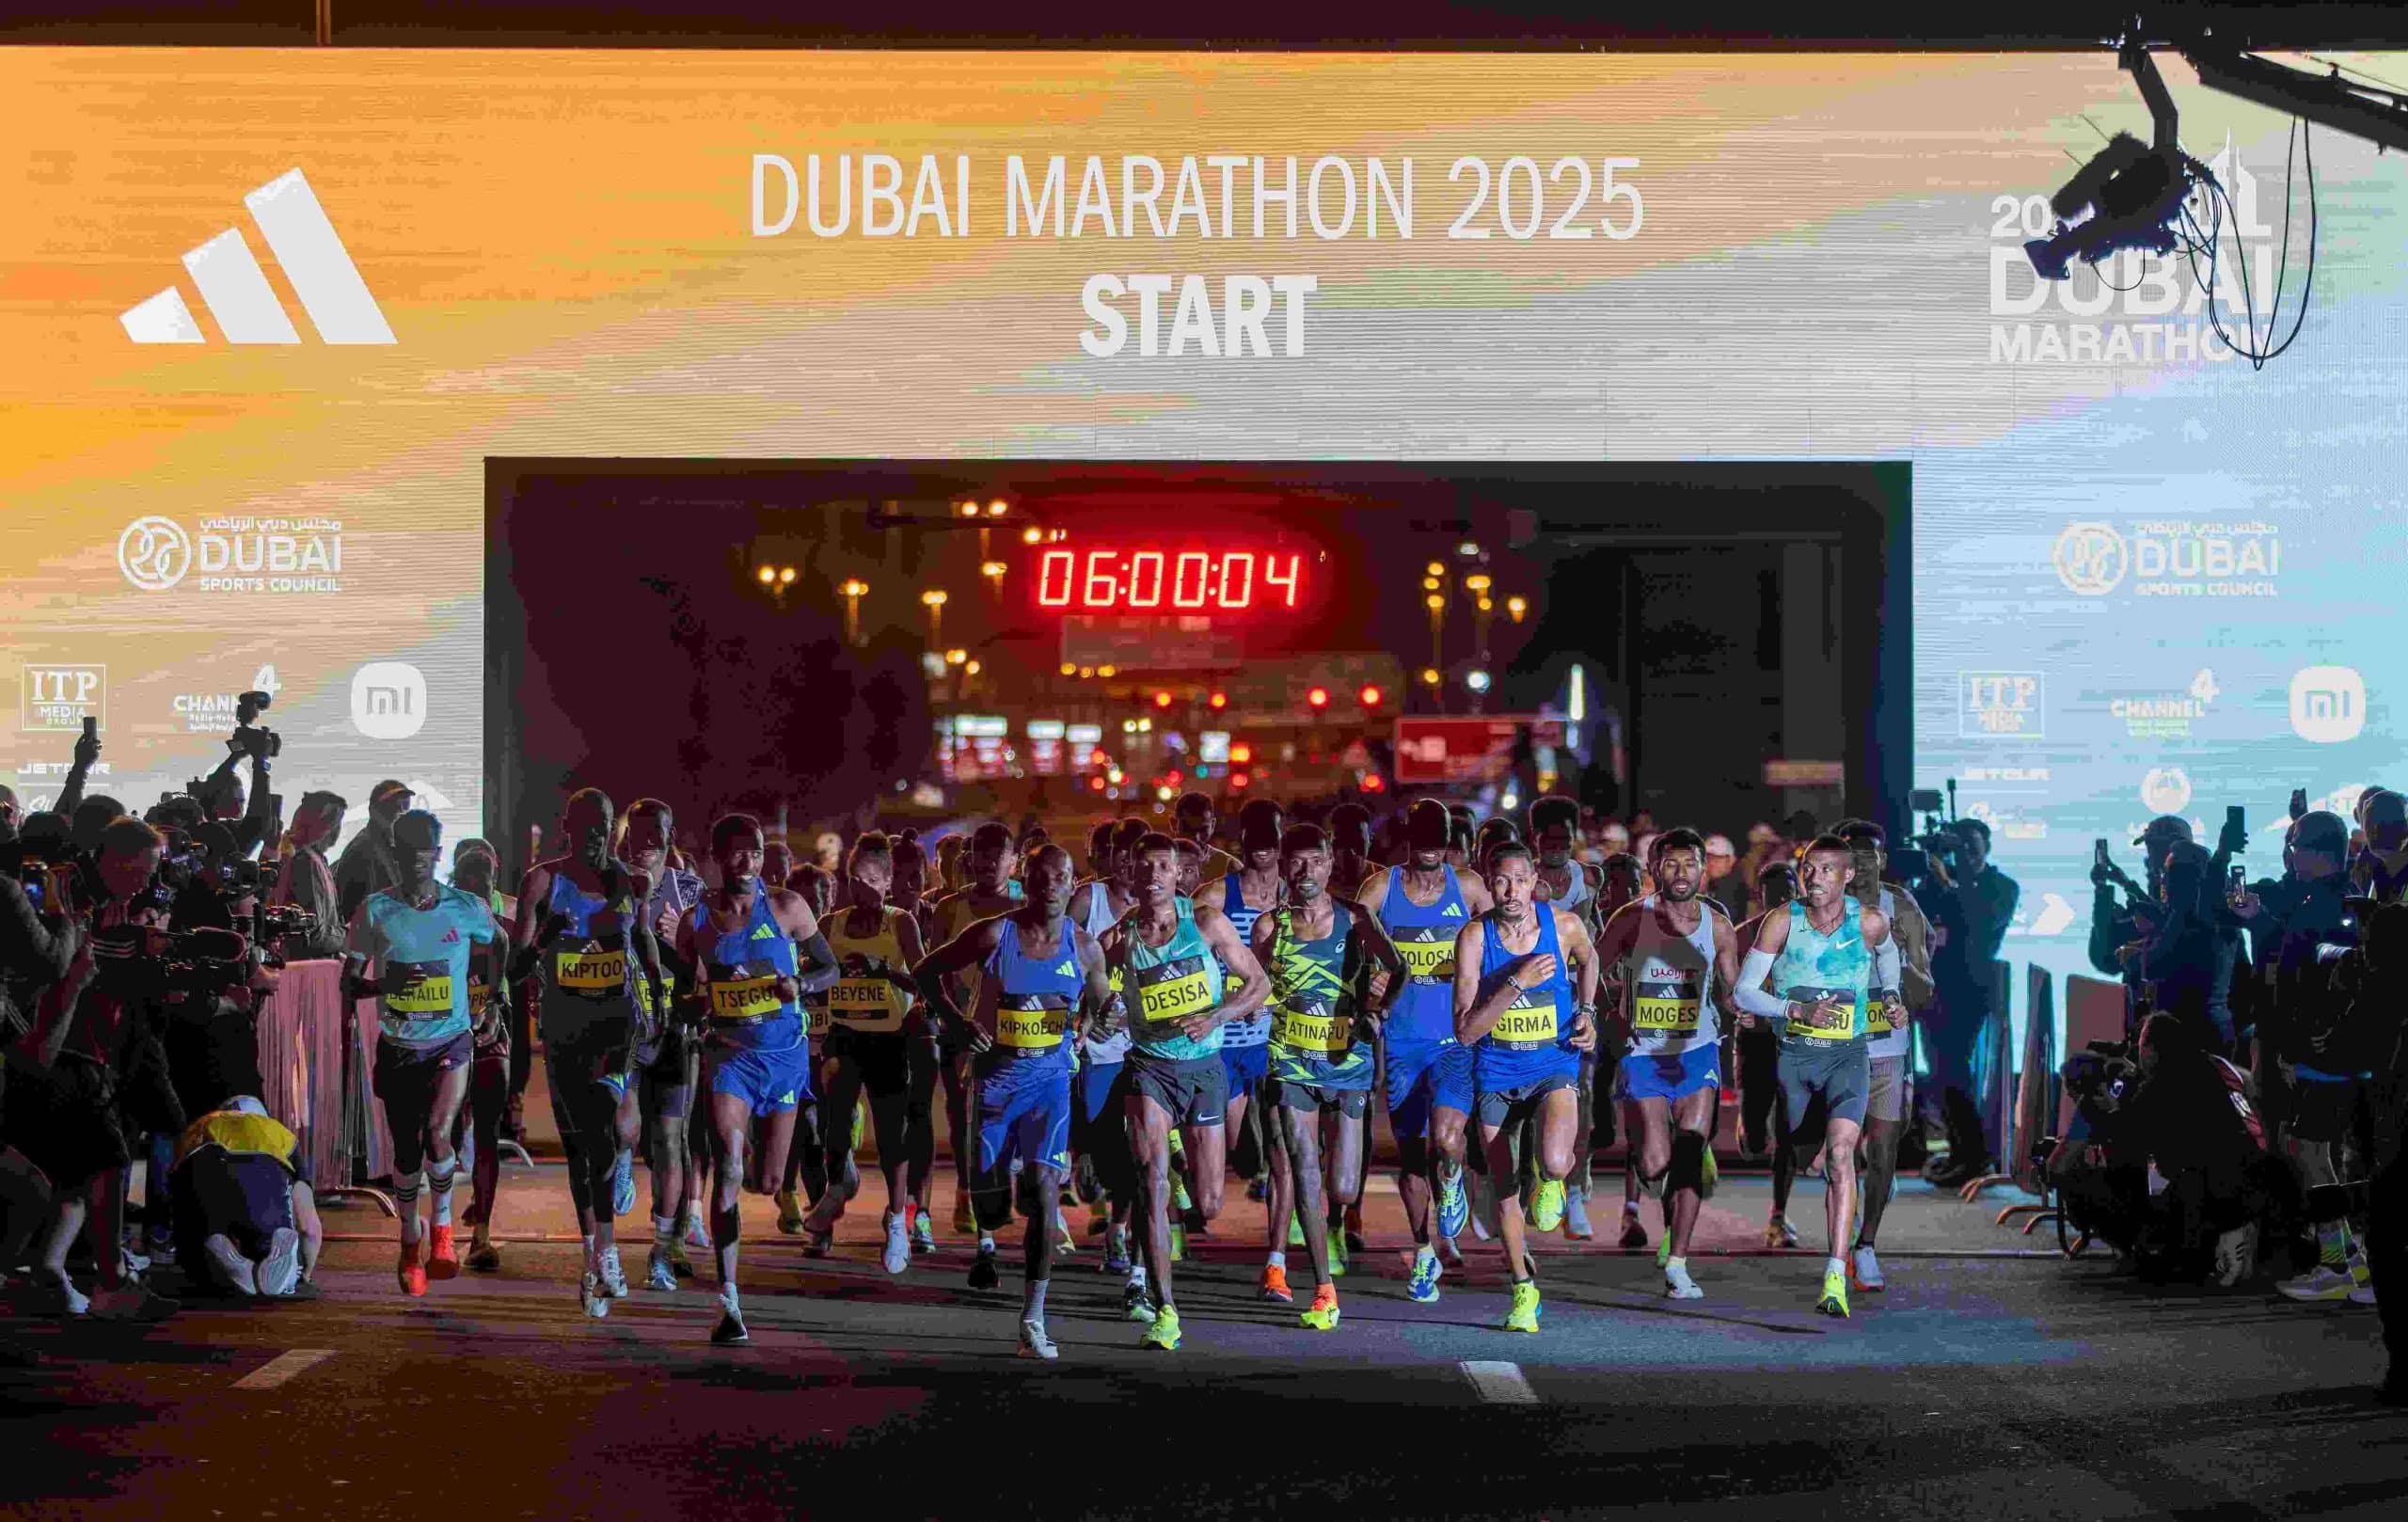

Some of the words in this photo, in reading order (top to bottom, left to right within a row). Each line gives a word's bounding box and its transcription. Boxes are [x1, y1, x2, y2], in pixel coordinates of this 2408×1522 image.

[752, 153, 970, 237] DUBAI
[1006, 155, 1414, 239] MARATHON
[1447, 156, 1645, 240] 2025
[1989, 246, 2273, 315] DUBAI
[1080, 273, 1317, 357] START
[1989, 324, 2273, 362] MARATHON
[199, 535, 341, 572] DUBAI
[2135, 539, 2281, 577] DUBAI
[199, 578, 264, 592] SPORTS
[270, 578, 341, 592] COUNCIL
[1038, 551, 1299, 608] 06:00:04
[31, 671, 97, 702] ITP
[173, 695, 240, 711] CHANN
[252, 664, 282, 700] 4
[1971, 676, 2036, 708] ITP
[2187, 668, 2220, 704] 4
[39, 706, 87, 718] MEDIA
[562, 959, 624, 979] KIPTOO
[831, 985, 886, 1002] BEYENE
[1145, 981, 1210, 1013] DESISA
[1000, 1019, 1064, 1036] KIPKOECH
[1289, 1020, 1344, 1040] ATINAFU
[1497, 1015, 1552, 1034] GIRMA
[1640, 1006, 1697, 1023] MOGES
